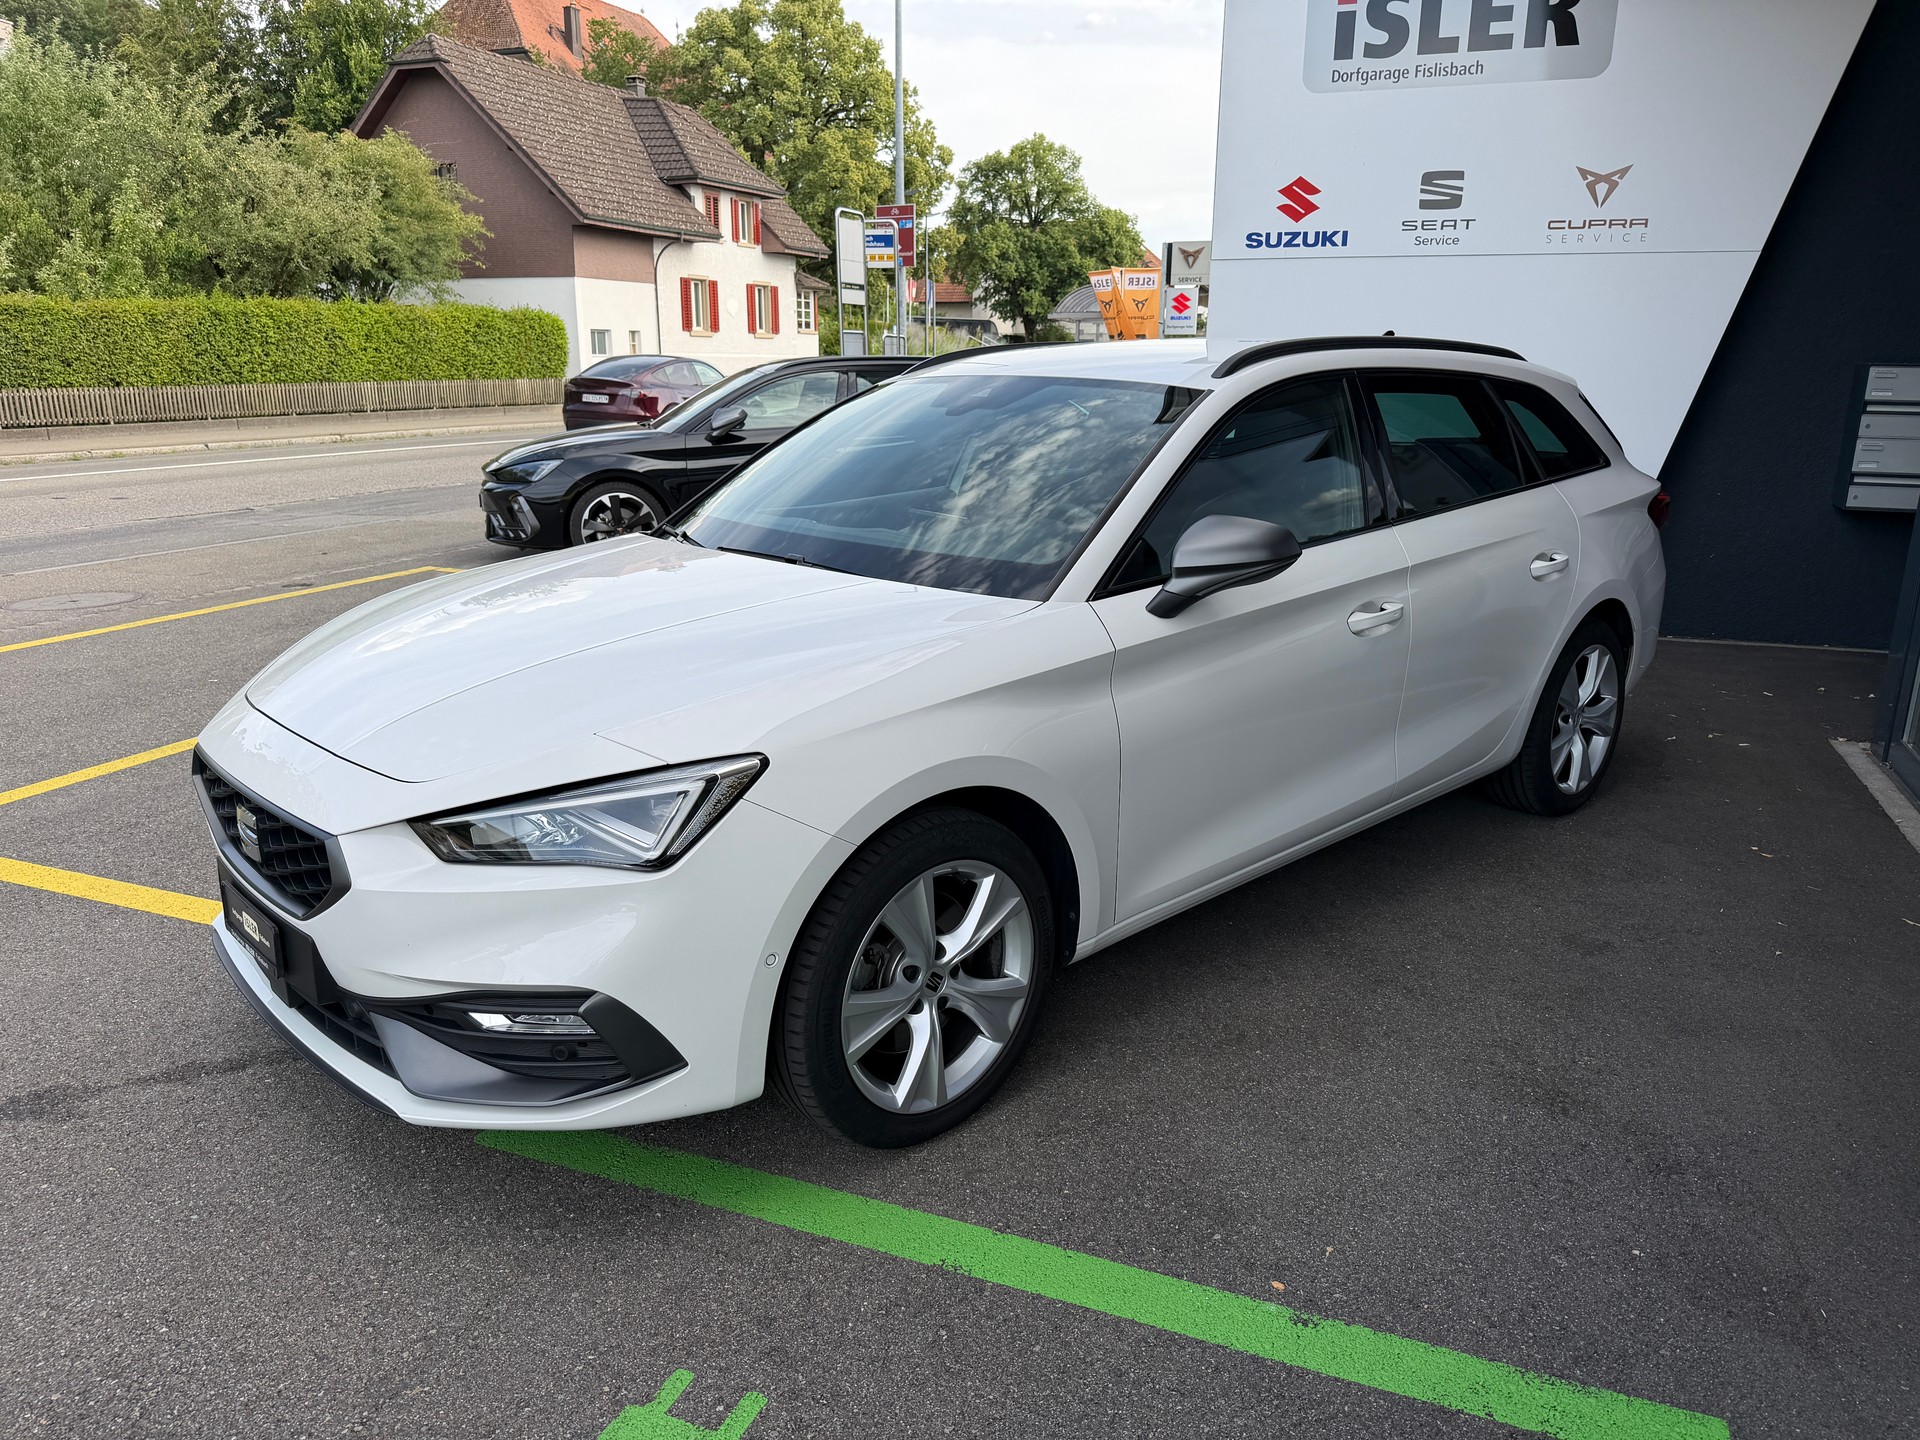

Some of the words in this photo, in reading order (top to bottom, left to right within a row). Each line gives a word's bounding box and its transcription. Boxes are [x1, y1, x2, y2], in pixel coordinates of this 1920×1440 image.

[1331, 66, 1410, 86] Dorfgarage
[1414, 60, 1485, 79] Fislisbach
[1401, 218, 1477, 232] SEAT
[1547, 217, 1650, 230] CUPRA
[1245, 230, 1349, 249] SUZUKI
[1413, 235, 1461, 247] Service
[1546, 232, 1648, 244] SERVICE
[1094, 278, 1113, 288] iSLE
